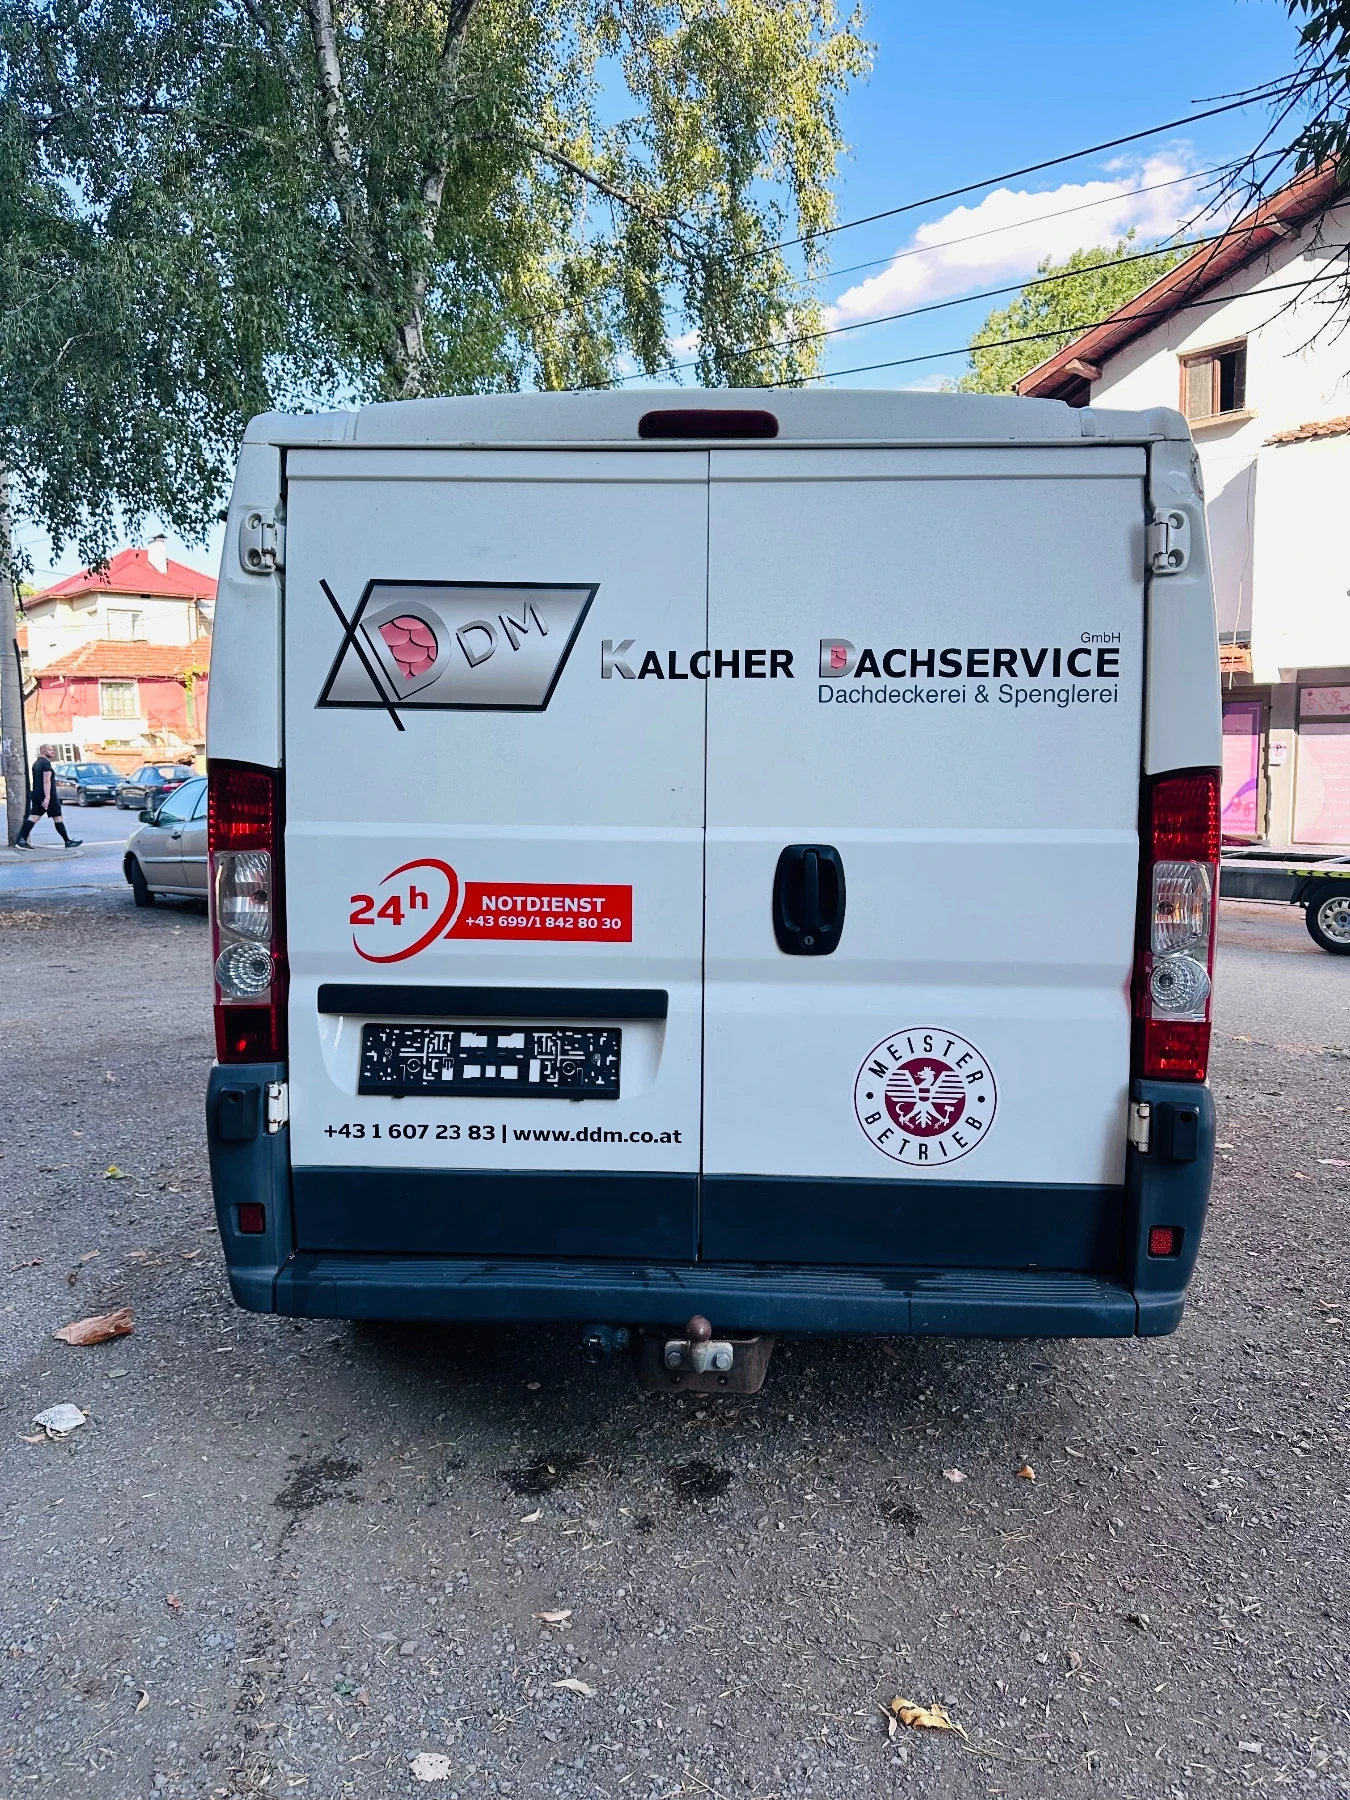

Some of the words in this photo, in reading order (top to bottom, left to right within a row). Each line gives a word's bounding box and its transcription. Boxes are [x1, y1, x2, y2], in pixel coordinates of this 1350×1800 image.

[1080, 632, 1121, 644] GmbH
[359, 598, 550, 701] DDM
[818, 684, 967, 704] Dachdeckerei
[974, 685, 989, 704] &
[998, 684, 1119, 708] Spenglerei
[481, 895, 606, 913] NOTDIENST
[465, 916, 495, 927] +43
[498, 916, 541, 929] 699/1
[545, 917, 574, 929] 842
[578, 918, 598, 929] 80
[602, 918, 622, 930] 30
[868, 1034, 984, 1084] MEISTER
[323, 1123, 366, 1139] +43
[371, 1124, 381, 1140] 1
[388, 1124, 430, 1140] 607
[435, 1125, 462, 1140] 23
[467, 1125, 496, 1140] 83
[513, 1127, 682, 1144] www.ddm.co.at
[864, 1111, 983, 1160] BETRIEB
